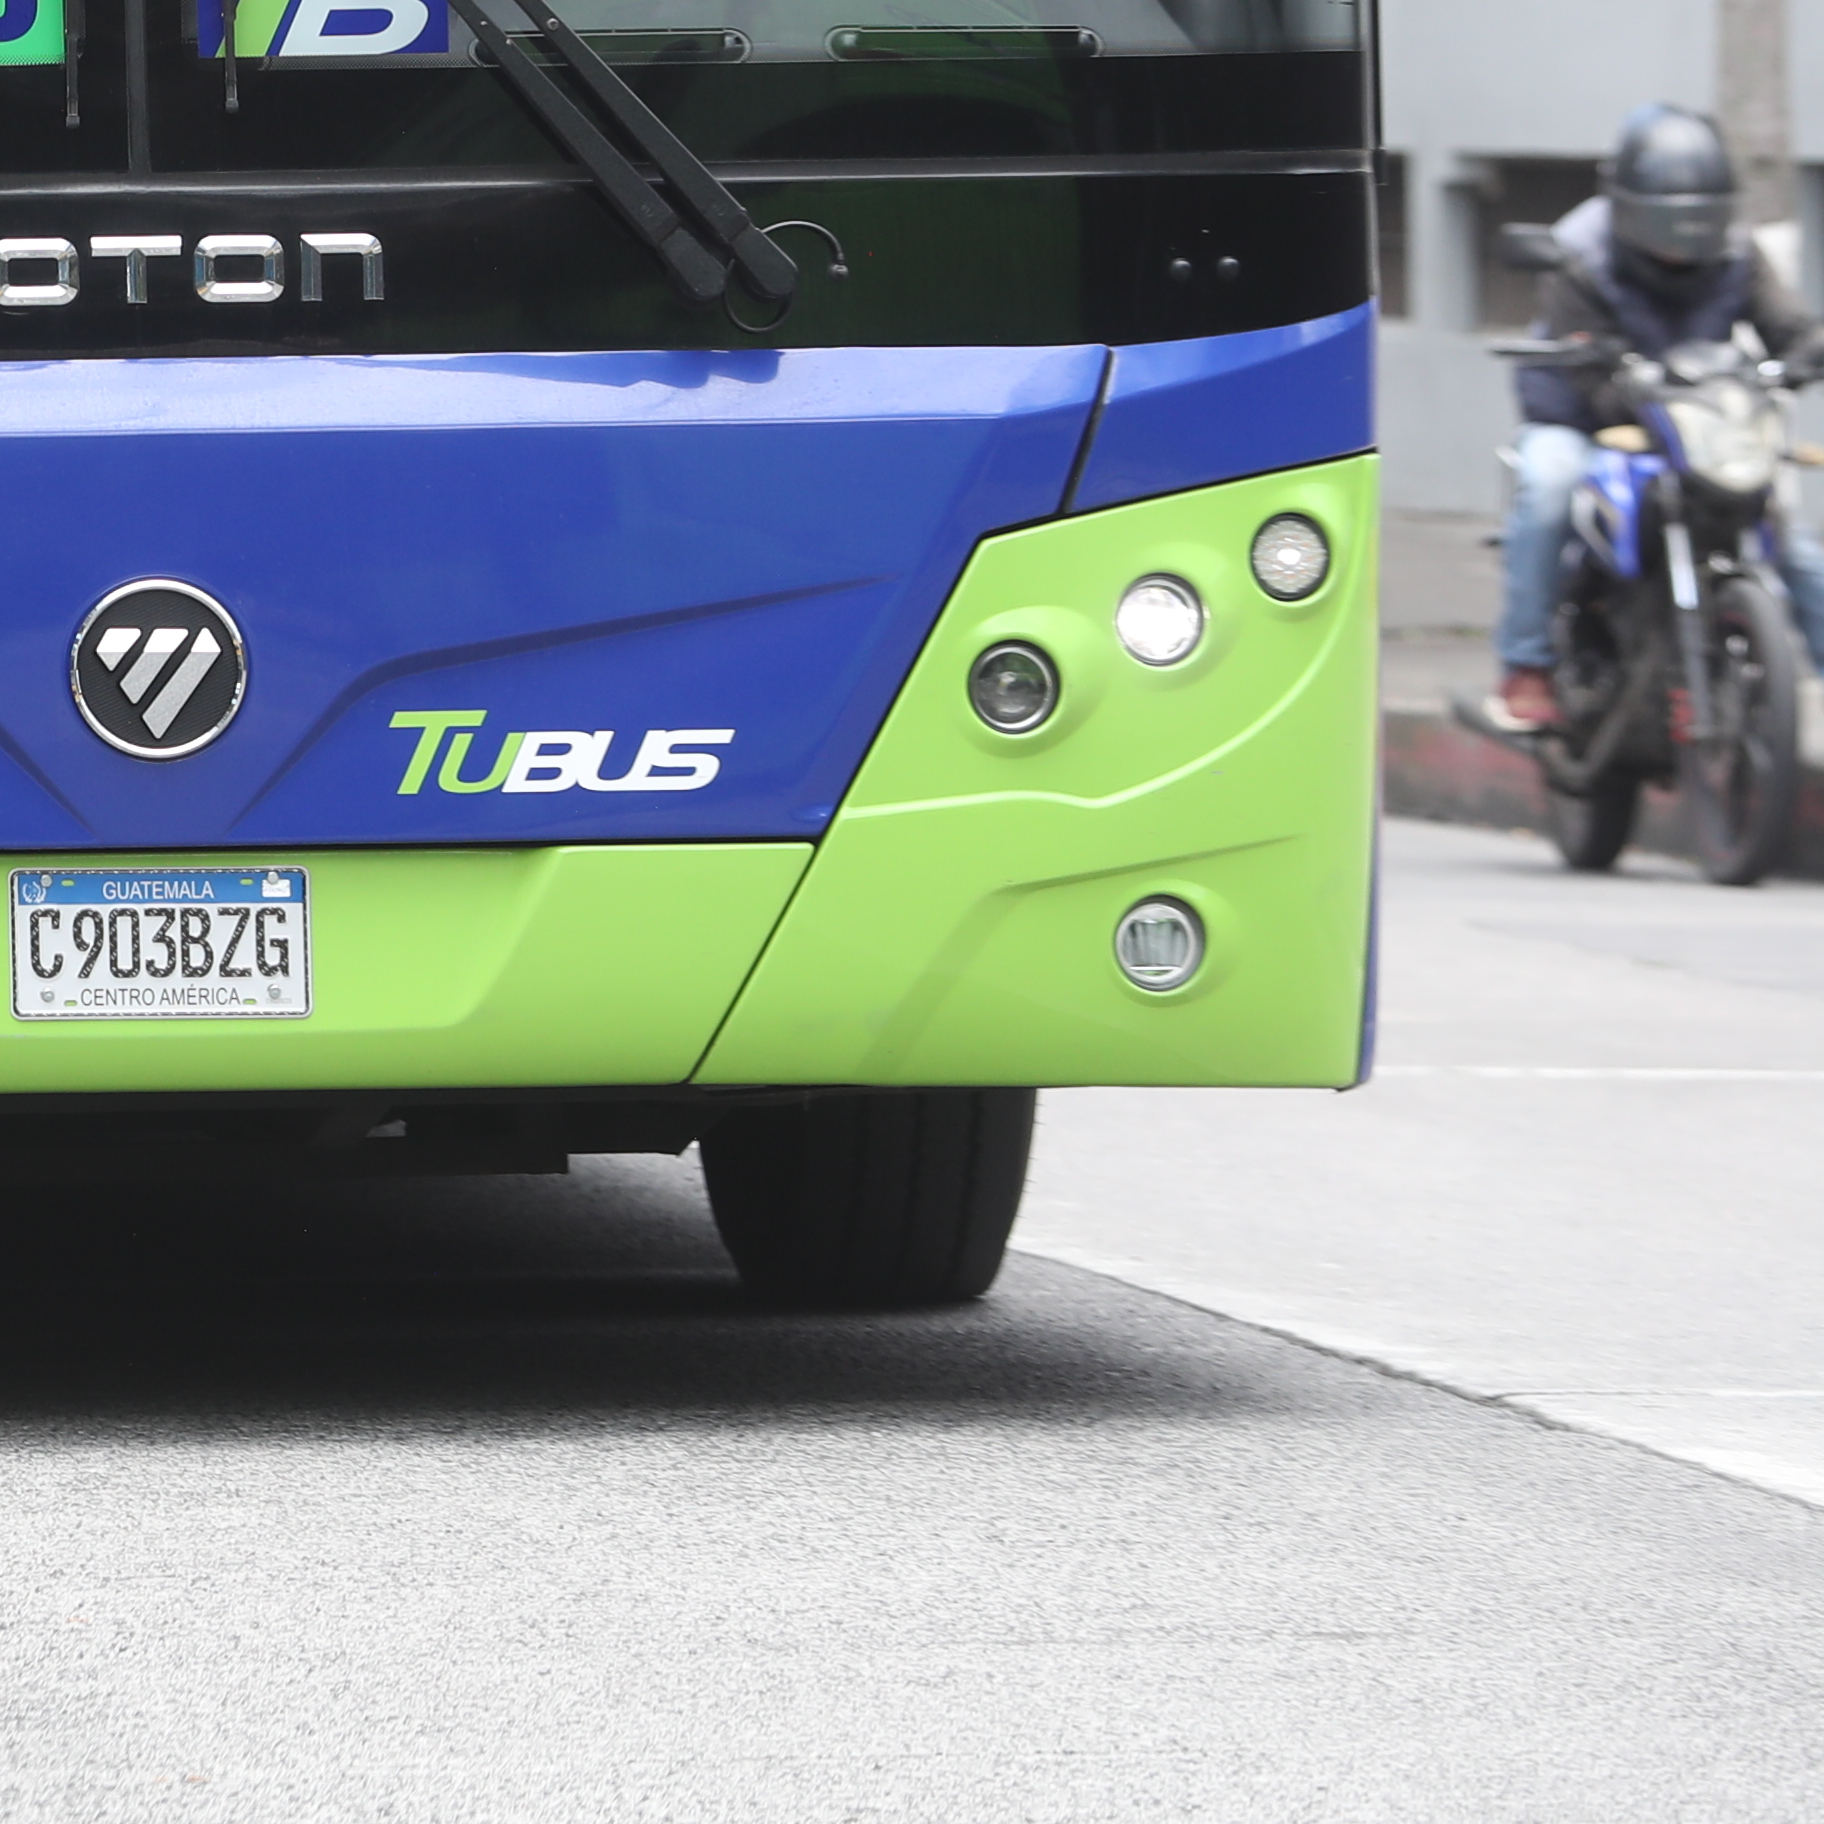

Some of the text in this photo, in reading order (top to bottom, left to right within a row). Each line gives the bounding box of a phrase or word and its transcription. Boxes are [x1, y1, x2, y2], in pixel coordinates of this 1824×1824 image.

[388, 709, 735, 795] TUBUS
[101, 879, 215, 900] GUATEMALA
[79, 984, 241, 1006] CENTRO AMÉRICA
